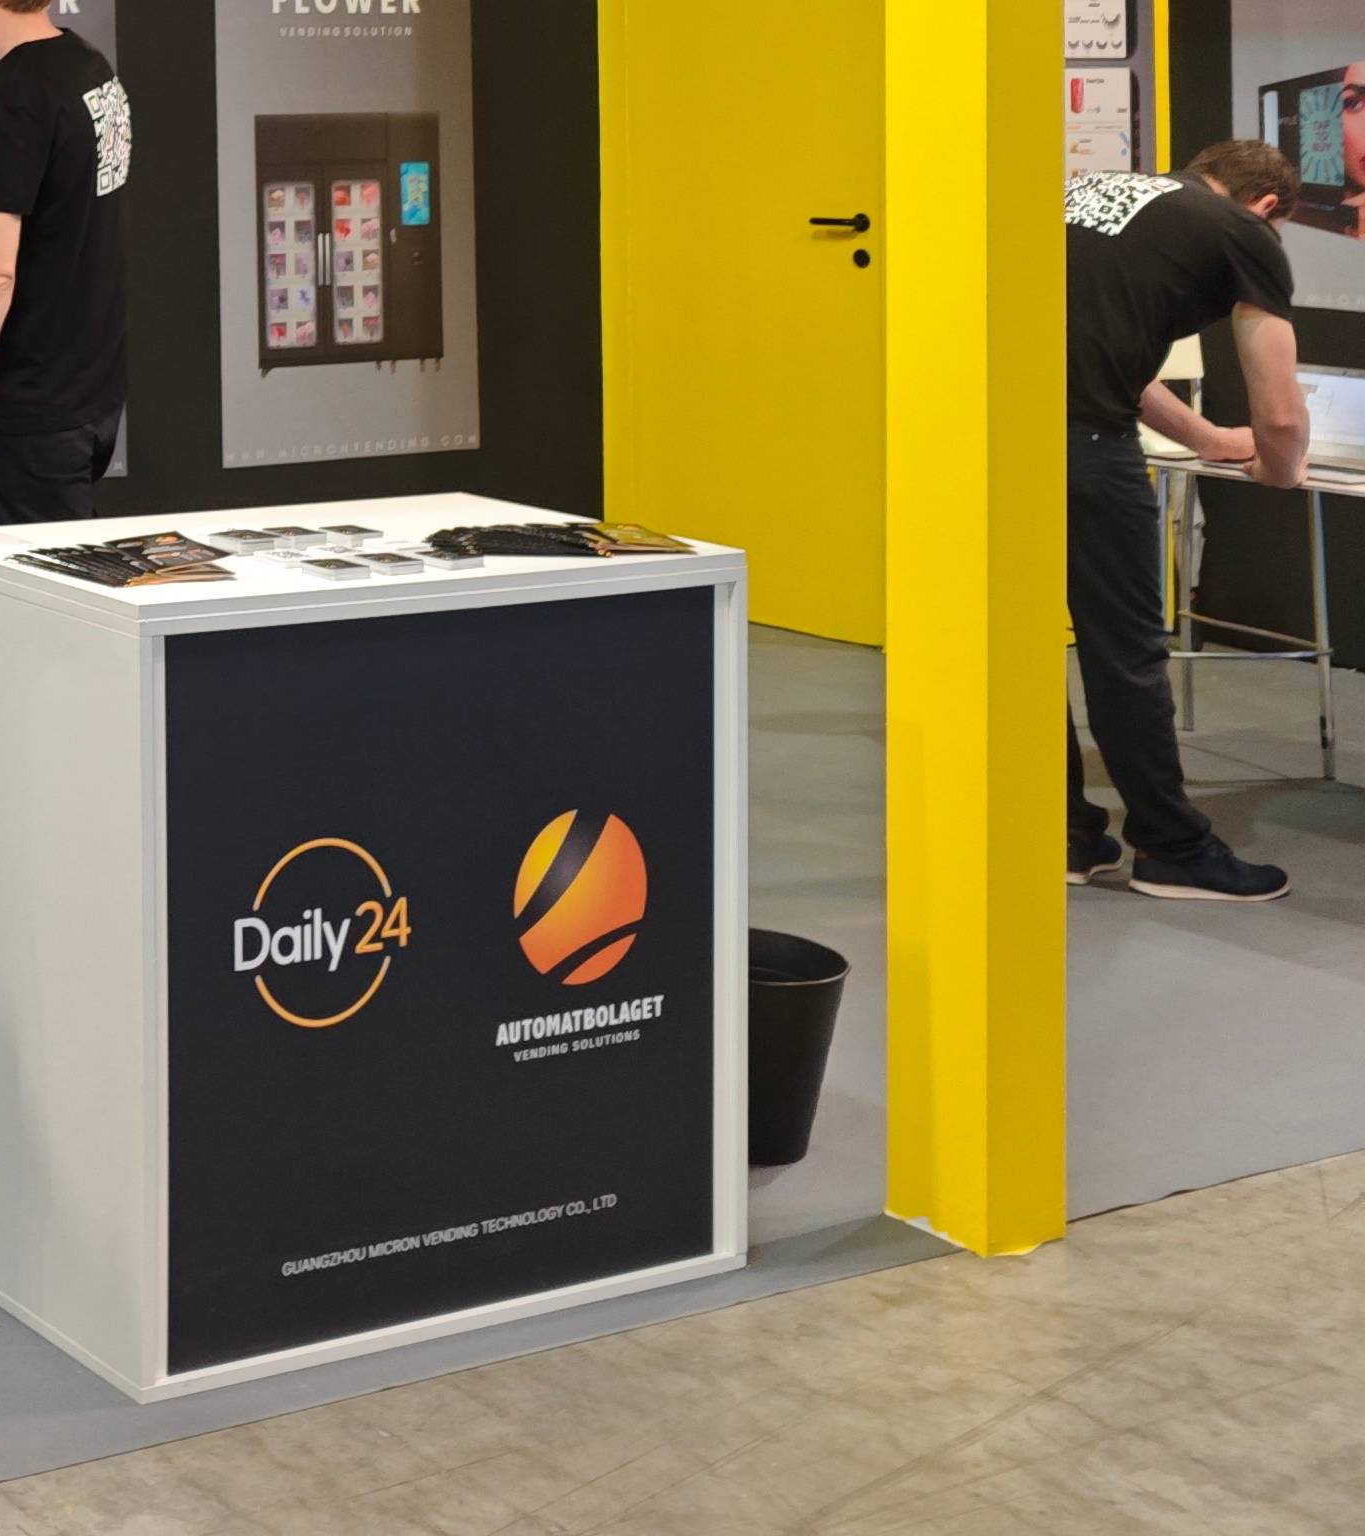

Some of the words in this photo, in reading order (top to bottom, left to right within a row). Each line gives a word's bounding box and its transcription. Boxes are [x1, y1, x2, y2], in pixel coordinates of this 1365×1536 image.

[233, 896, 412, 972] Daily24
[495, 994, 665, 1047] AUTOMATBOLAGET
[513, 1042, 569, 1063] VENDING
[572, 1029, 641, 1052] SOLUTIONS
[281, 1246, 367, 1277] GUANGZHOU
[368, 1235, 421, 1259] MICRON
[422, 1223, 479, 1248] VENDING
[481, 1204, 565, 1236] TECHNOLOGY
[593, 1193, 618, 1211] LTD
